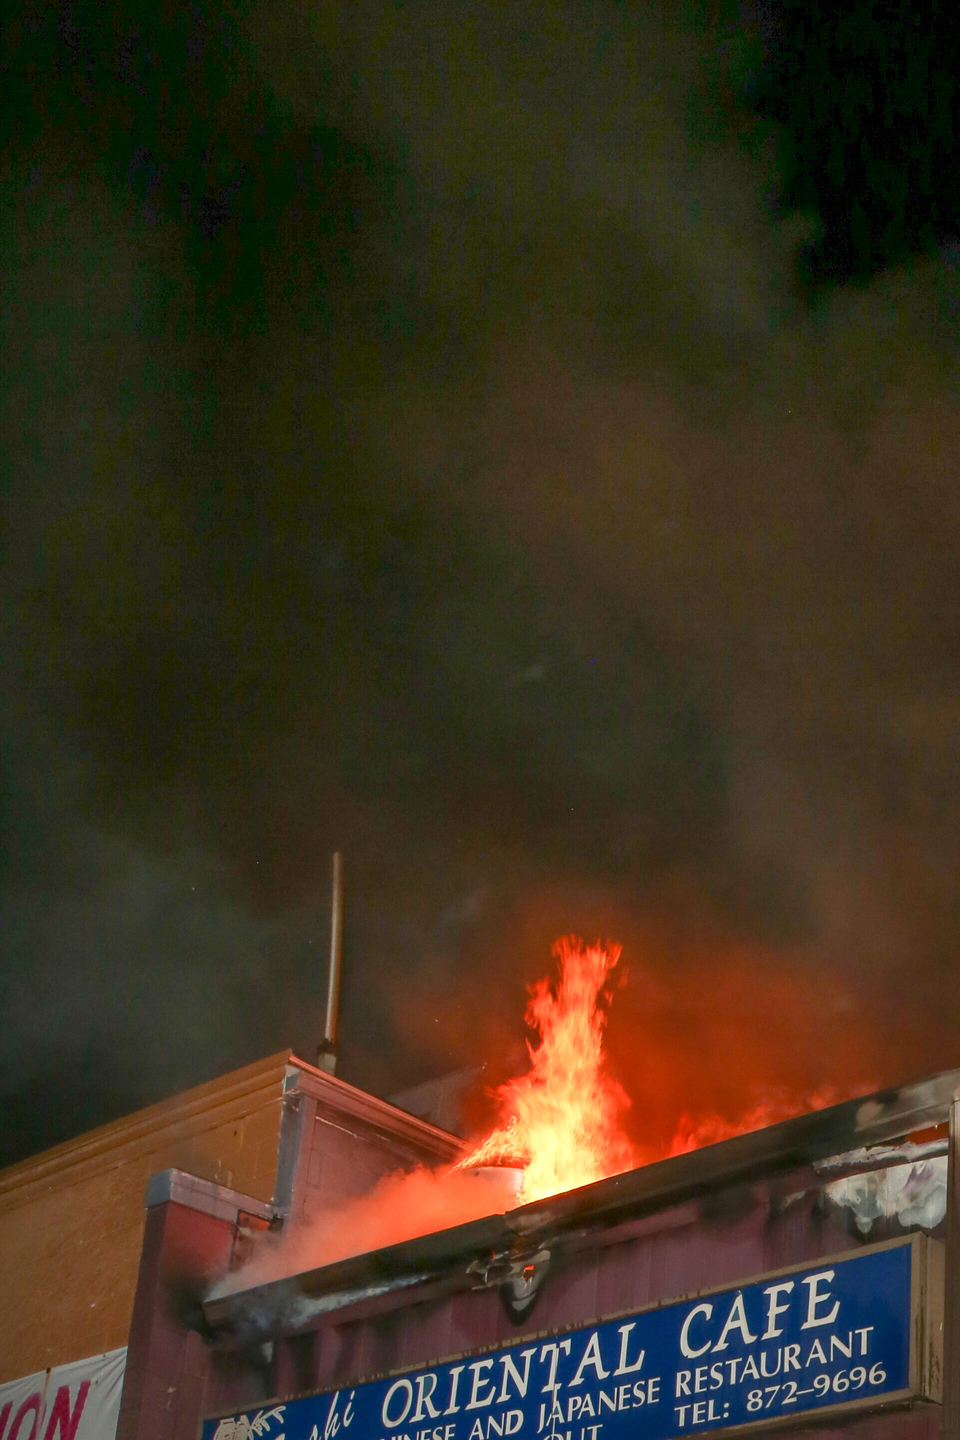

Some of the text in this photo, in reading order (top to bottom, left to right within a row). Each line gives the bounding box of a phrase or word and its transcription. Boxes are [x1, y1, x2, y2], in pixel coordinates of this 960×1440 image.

[382, 1269, 841, 1428] ORIENTAL CAFE
[536, 1377, 661, 1434] JAPANESE
[675, 1327, 875, 1398] RESTAURANT
[674, 1360, 887, 1427] TEL: 872-9696
